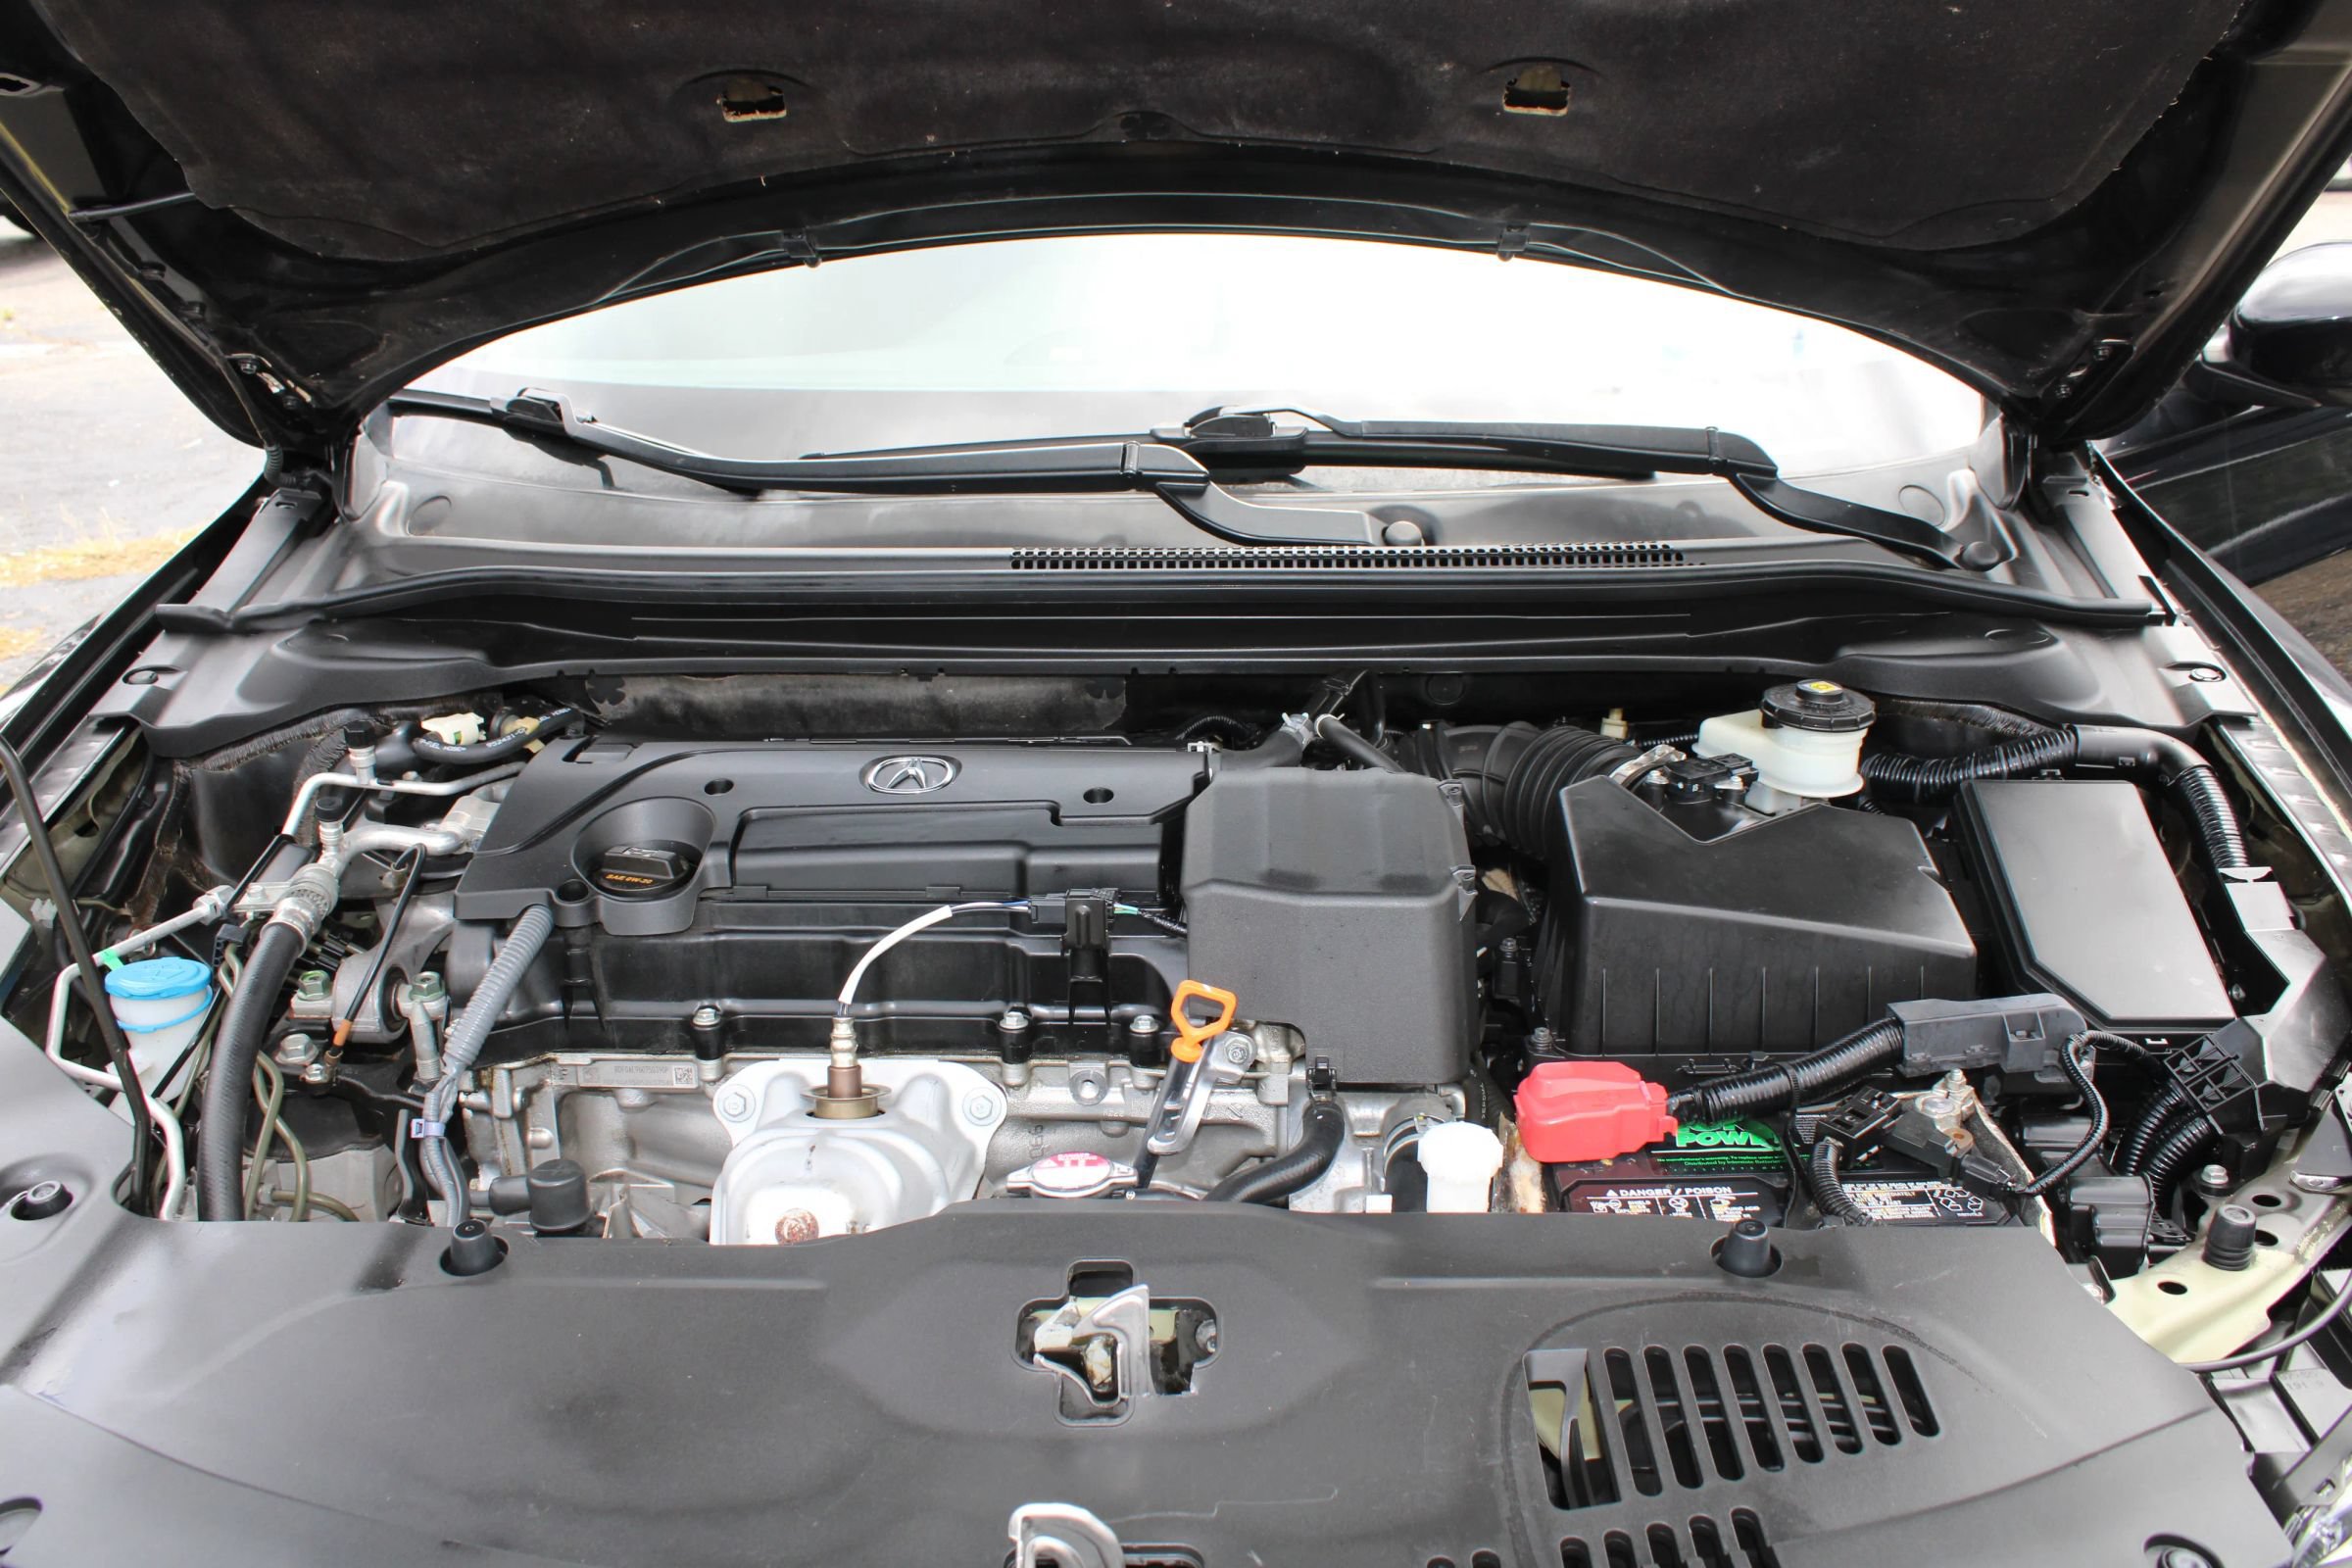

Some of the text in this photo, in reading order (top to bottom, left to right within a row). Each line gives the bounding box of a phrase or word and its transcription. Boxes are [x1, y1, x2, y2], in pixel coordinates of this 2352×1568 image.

[1676, 1130, 1783, 1148] POW
[1619, 1188, 1672, 1197] DANGER
[1685, 1186, 1732, 1195] POISON
